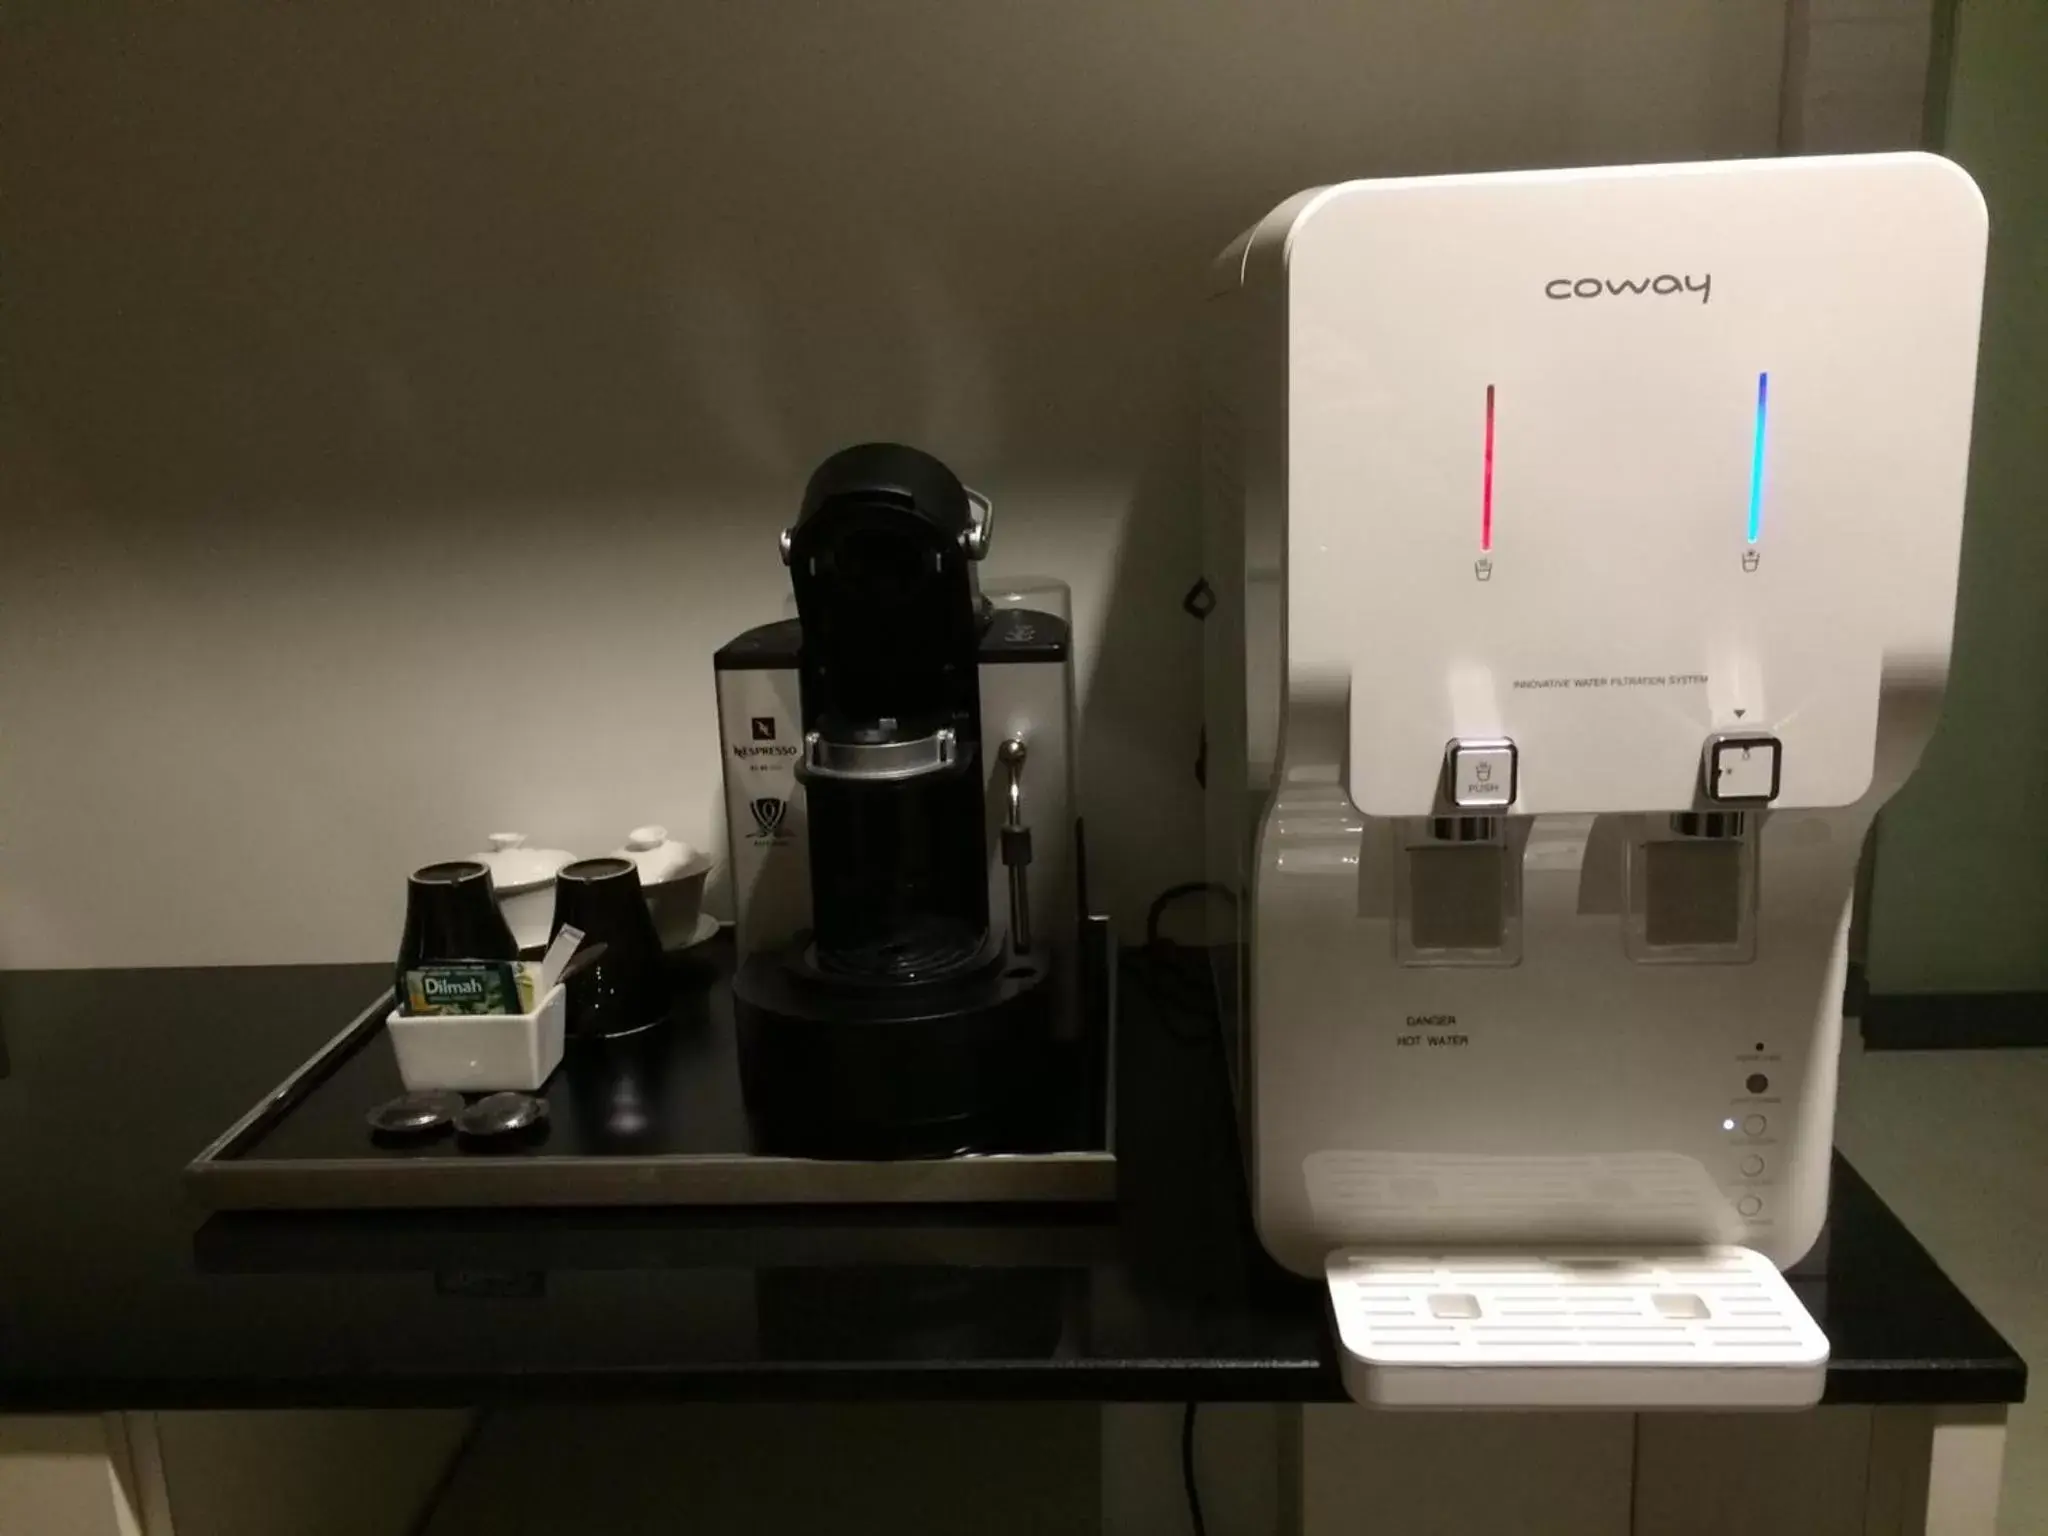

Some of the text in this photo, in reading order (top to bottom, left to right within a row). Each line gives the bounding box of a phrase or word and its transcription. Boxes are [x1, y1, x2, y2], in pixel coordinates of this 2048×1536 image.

[1513, 674, 1709, 689] INNOVATIVE WATER FILTRATION SYSTEM
[1468, 784, 1499, 793] PUSH
[425, 977, 482, 995] Dilmah
[1406, 1015, 1456, 1026] DANGER
[1397, 1035, 1469, 1046] HOT WATER
